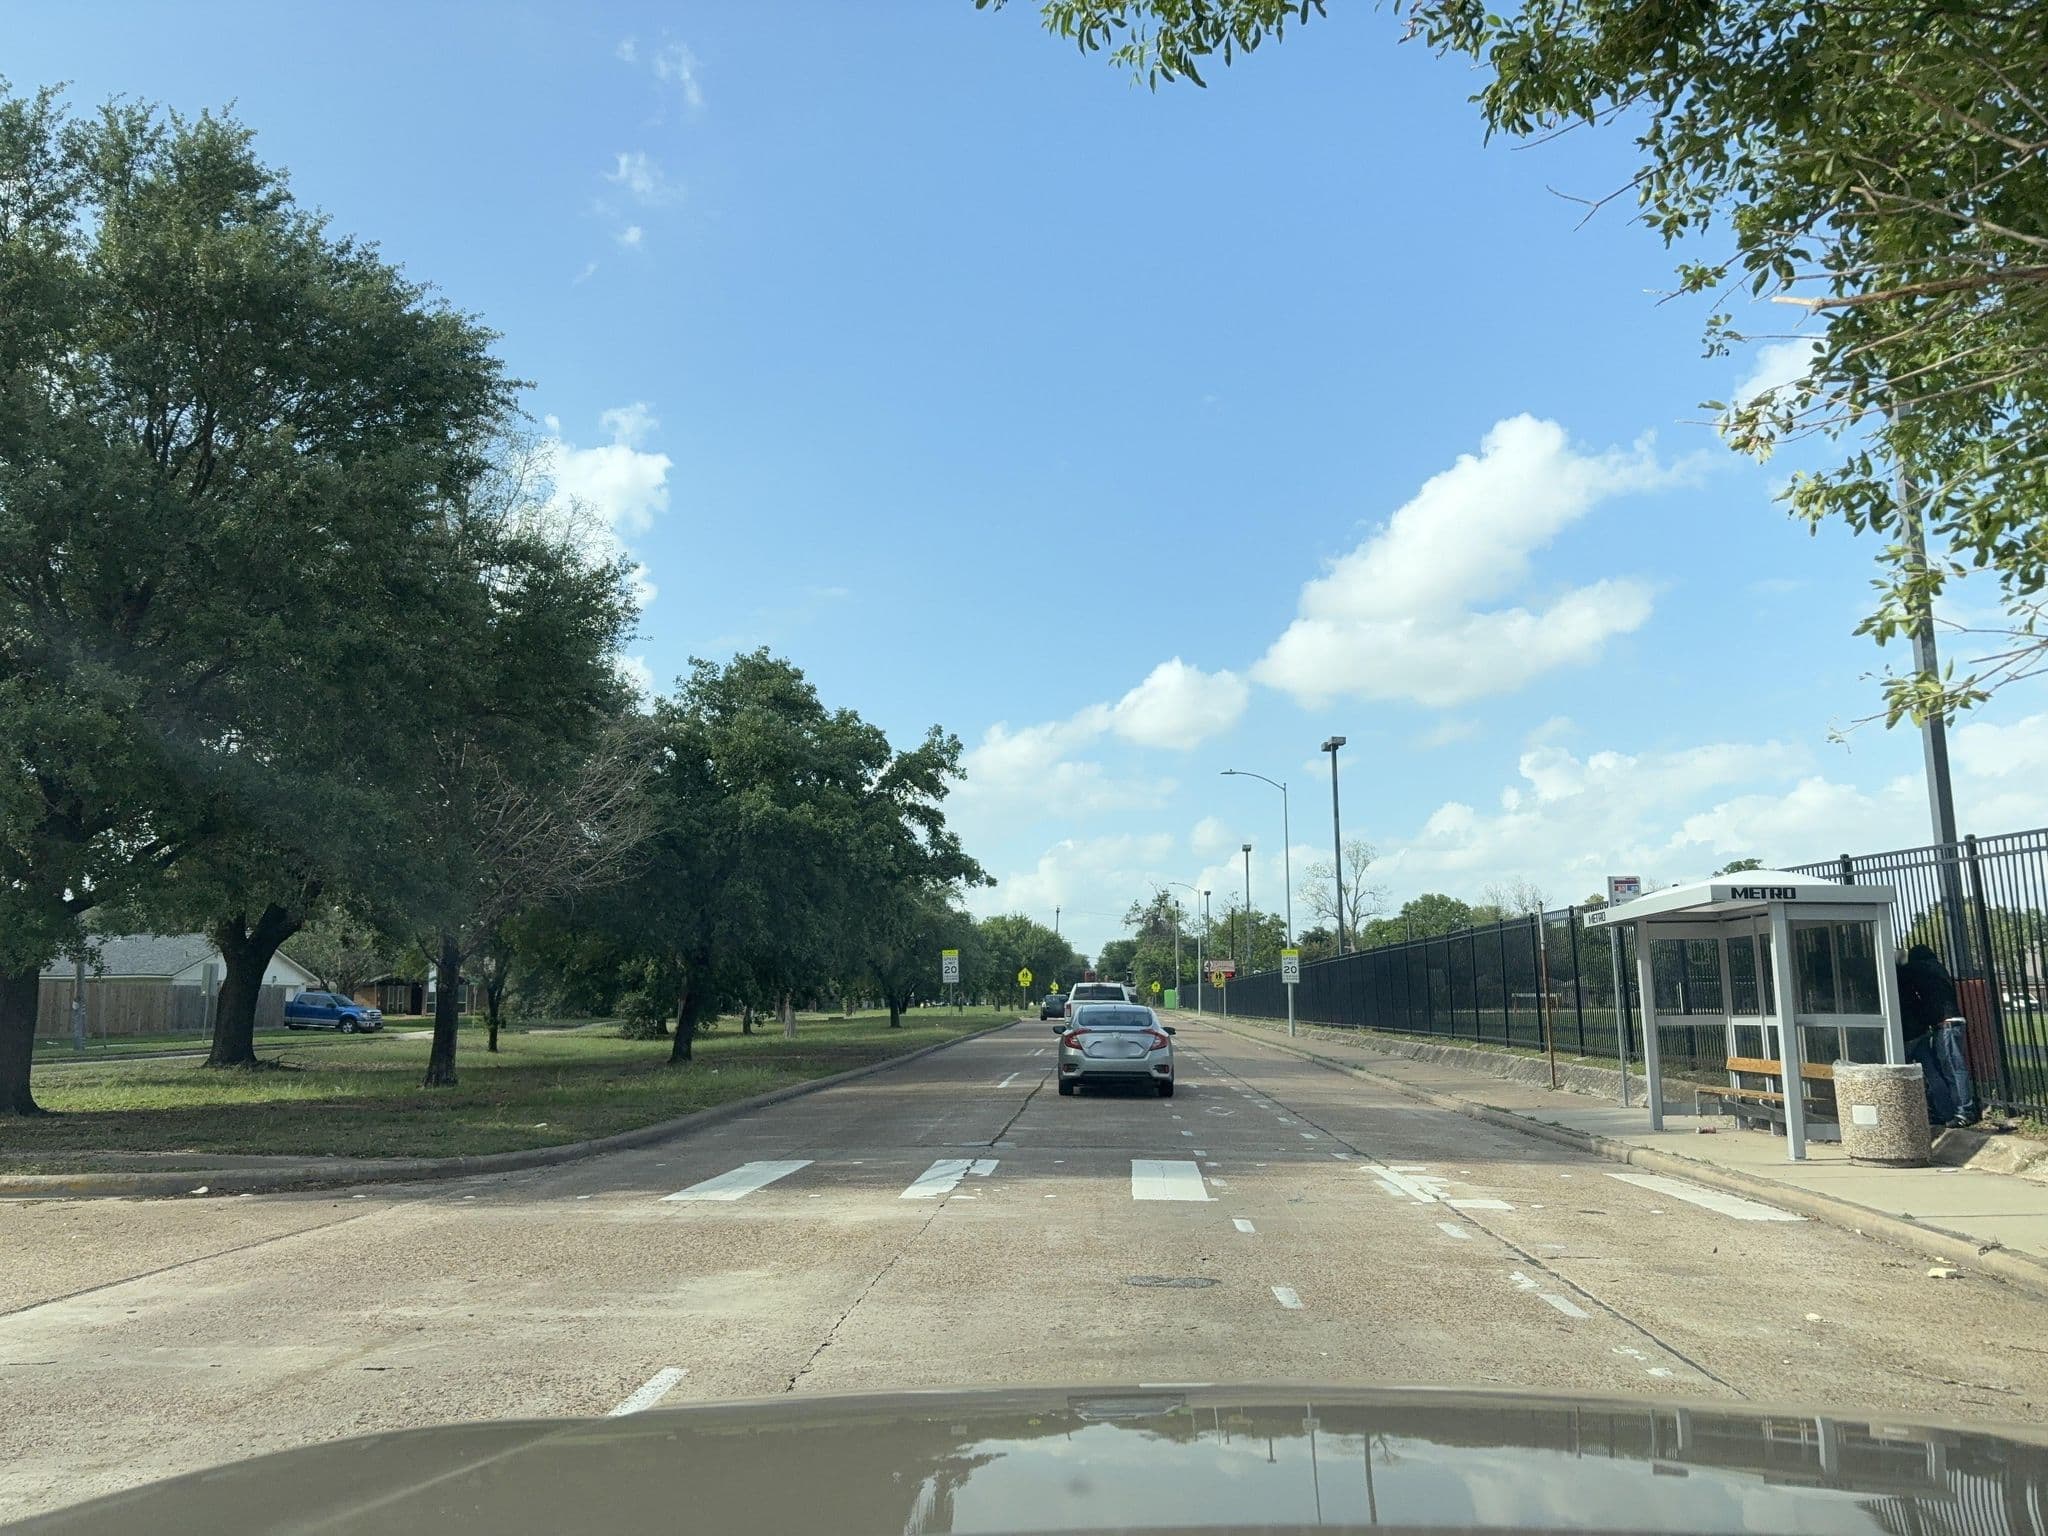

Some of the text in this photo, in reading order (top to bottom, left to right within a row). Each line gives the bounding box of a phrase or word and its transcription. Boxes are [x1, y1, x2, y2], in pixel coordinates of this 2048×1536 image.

[1731, 887, 1796, 899] METRO
[944, 966, 957, 974] 20
[1283, 966, 1297, 974] 20
